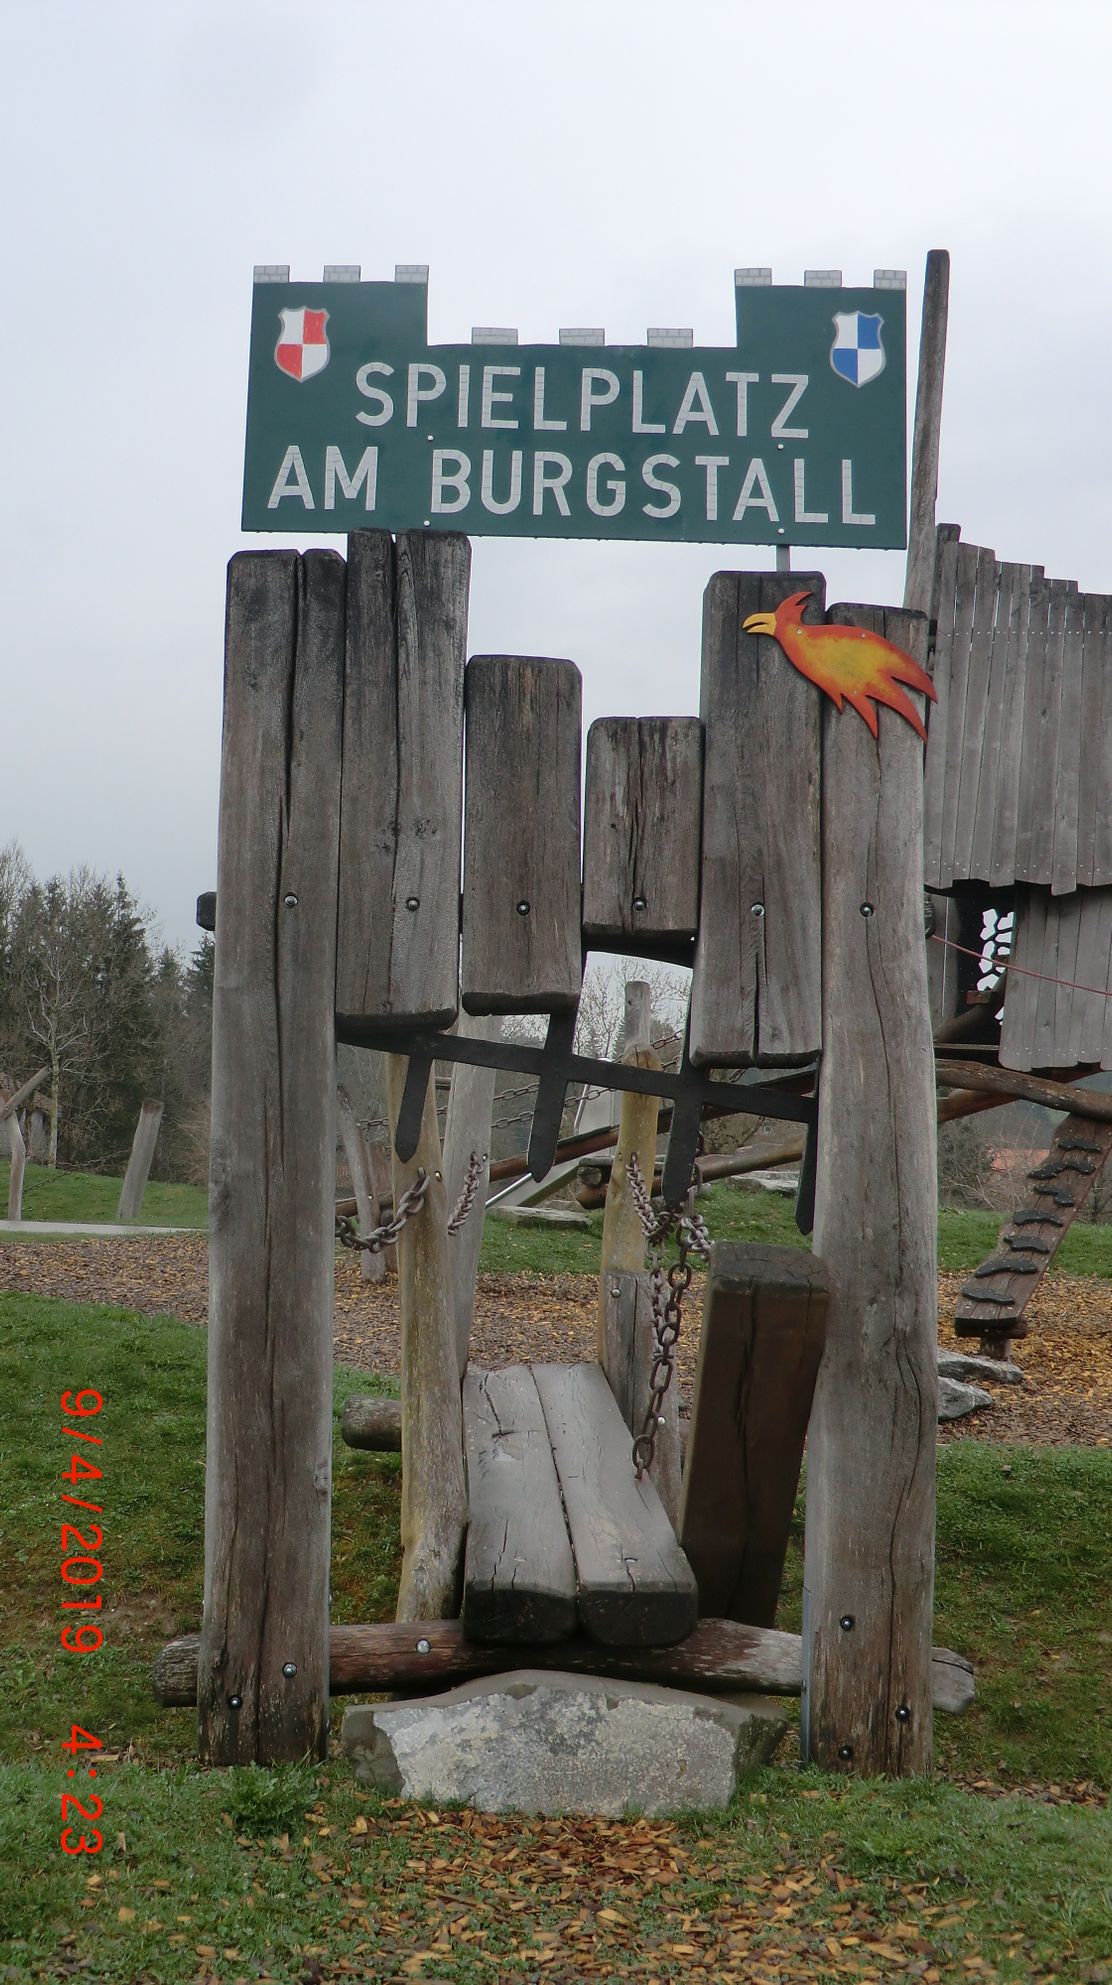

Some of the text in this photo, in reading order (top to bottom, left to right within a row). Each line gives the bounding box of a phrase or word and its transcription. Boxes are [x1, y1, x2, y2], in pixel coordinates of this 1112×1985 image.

[355, 361, 809, 438] SPIELPLATZ
[267, 445, 876, 525] AM BURGSTALL
